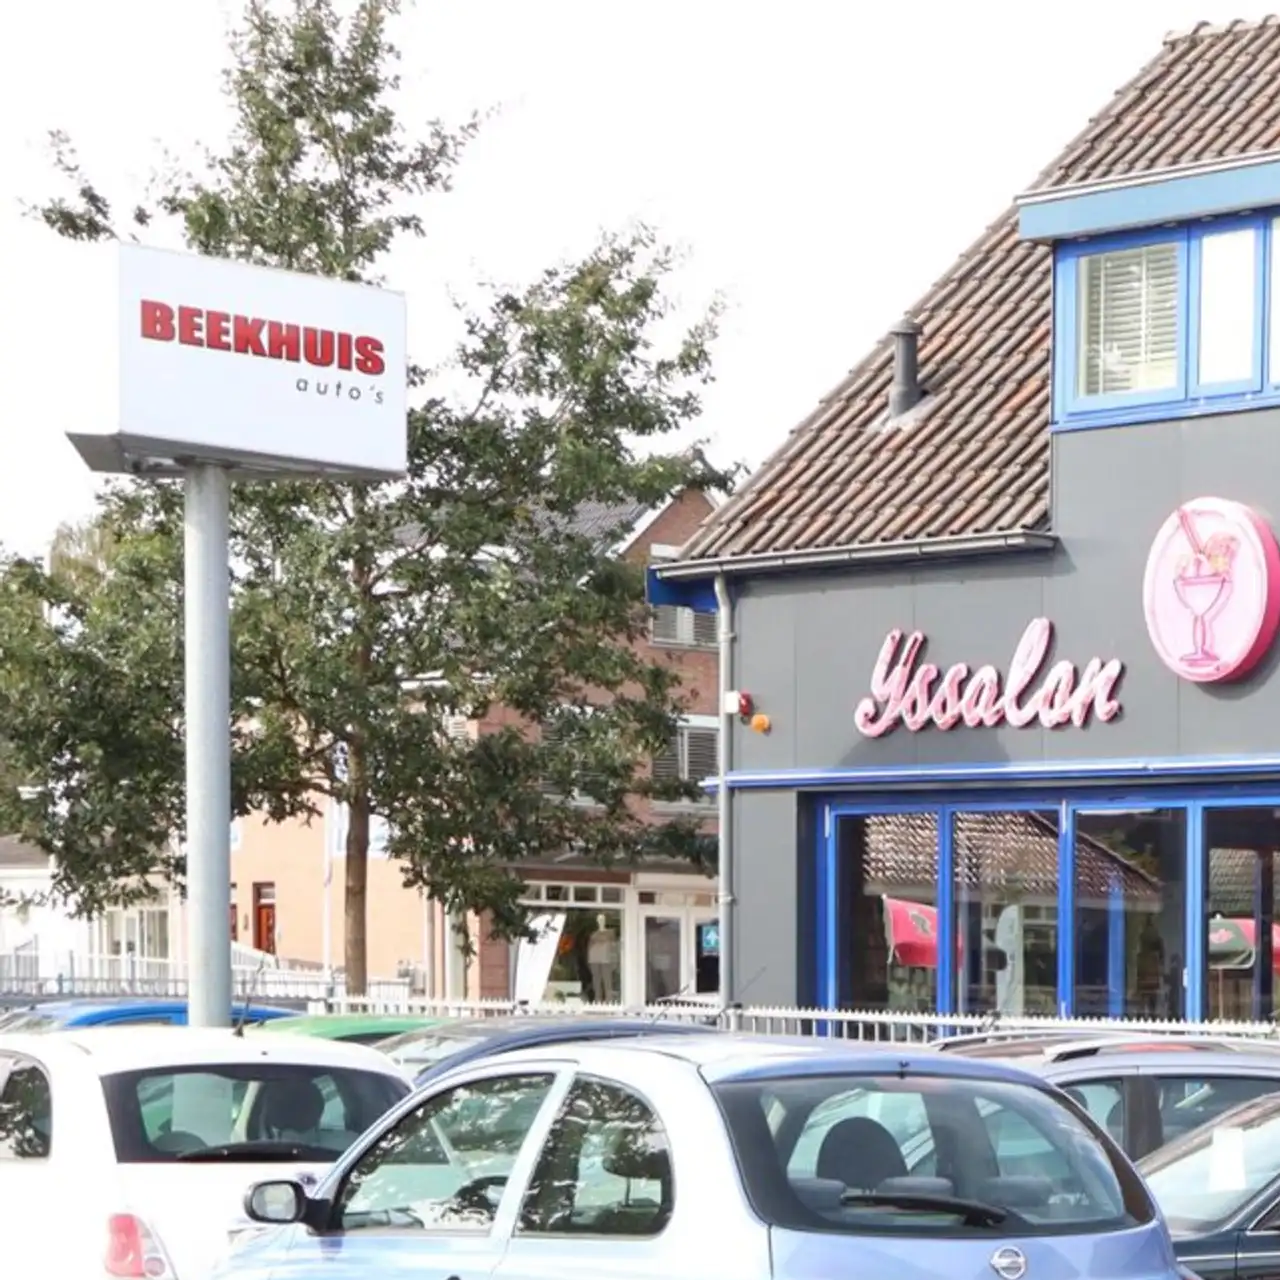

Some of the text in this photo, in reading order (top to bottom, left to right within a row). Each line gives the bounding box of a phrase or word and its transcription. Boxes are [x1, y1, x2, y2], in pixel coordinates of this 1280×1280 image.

[140, 299, 386, 377] BEEKHUIS
[296, 377, 384, 404] auto's
[854, 616, 1122, 738] Yssalon
